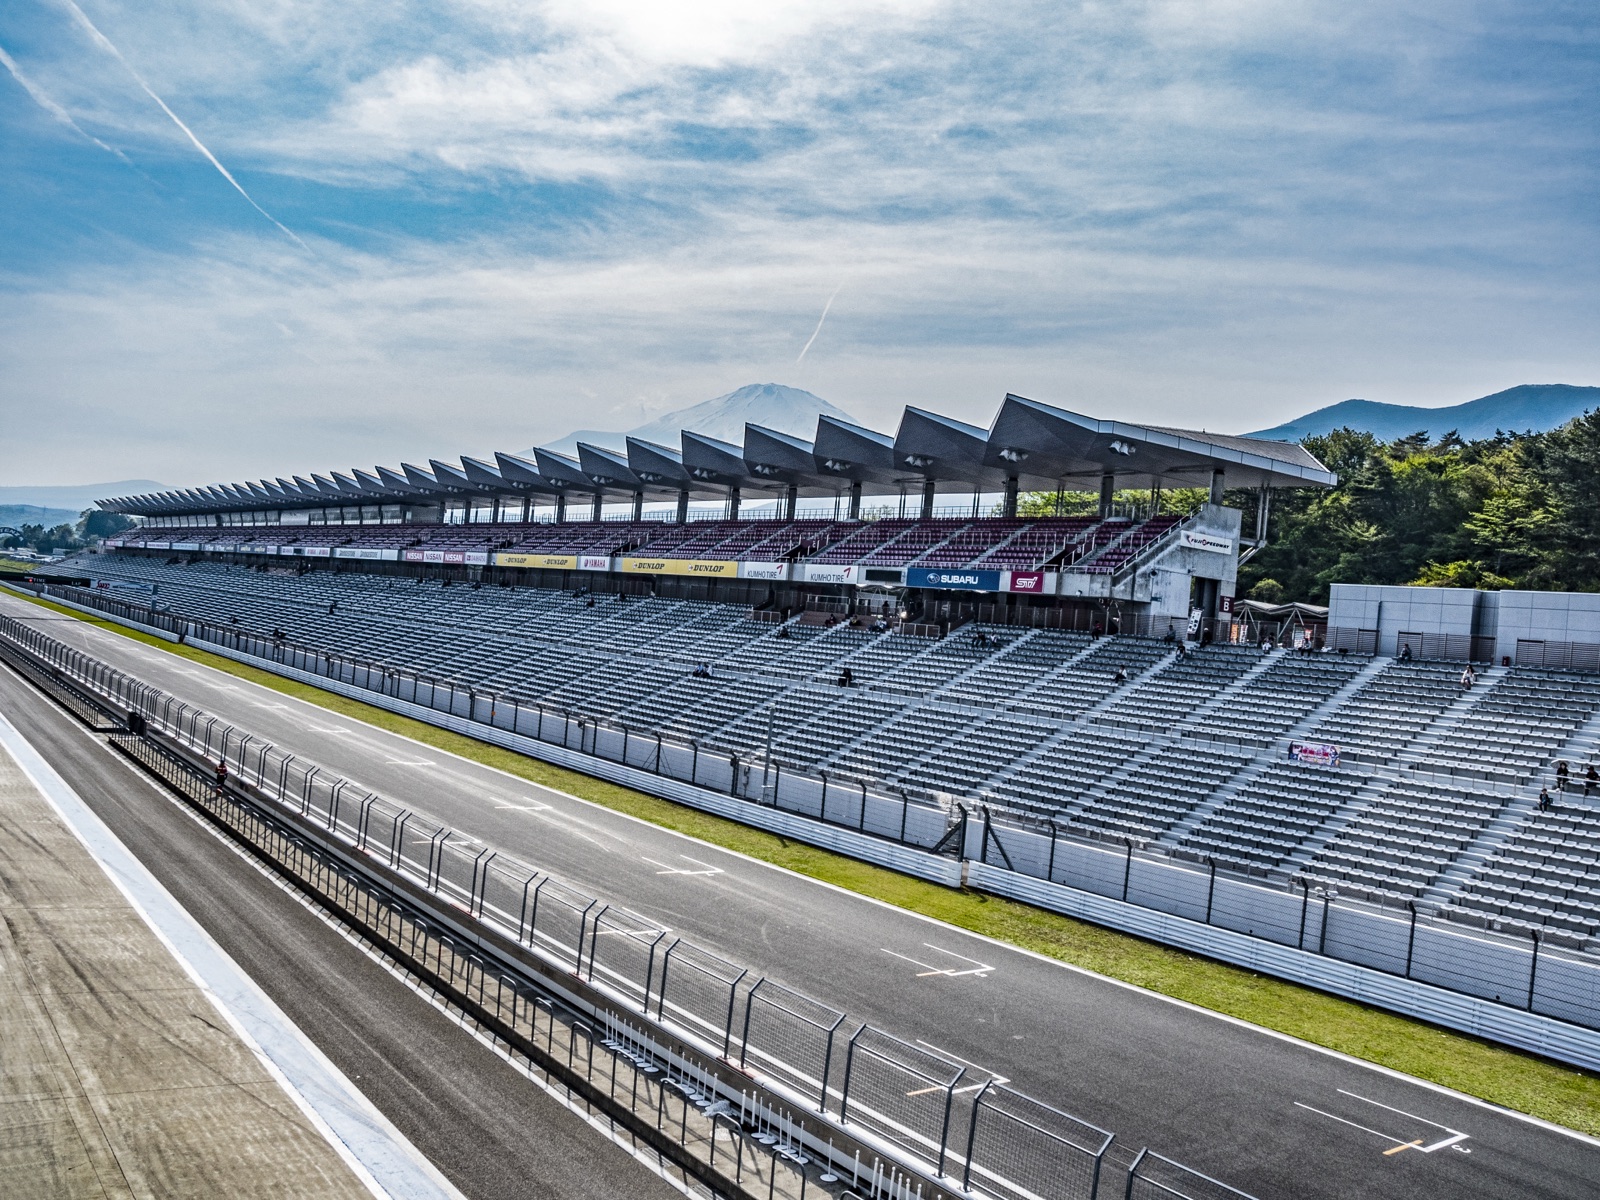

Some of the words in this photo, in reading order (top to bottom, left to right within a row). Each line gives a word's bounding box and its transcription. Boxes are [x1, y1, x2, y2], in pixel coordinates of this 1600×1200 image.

[406, 552, 423, 560] NISSAN
[425, 553, 442, 561] NISSAN
[445, 553, 463, 562] NISSAN
[546, 558, 568, 566] DUNLOP
[588, 559, 606, 568] YAMAHA
[637, 562, 665, 570] DUNLOP
[693, 564, 725, 573] DUNLOP
[747, 570, 766, 579] KUMHO
[766, 571, 777, 579] TIRE
[811, 573, 831, 582] KUMHO
[832, 574, 844, 582] TIRE
[940, 575, 979, 585] SUBARU
[1223, 601, 1230, 611] B
